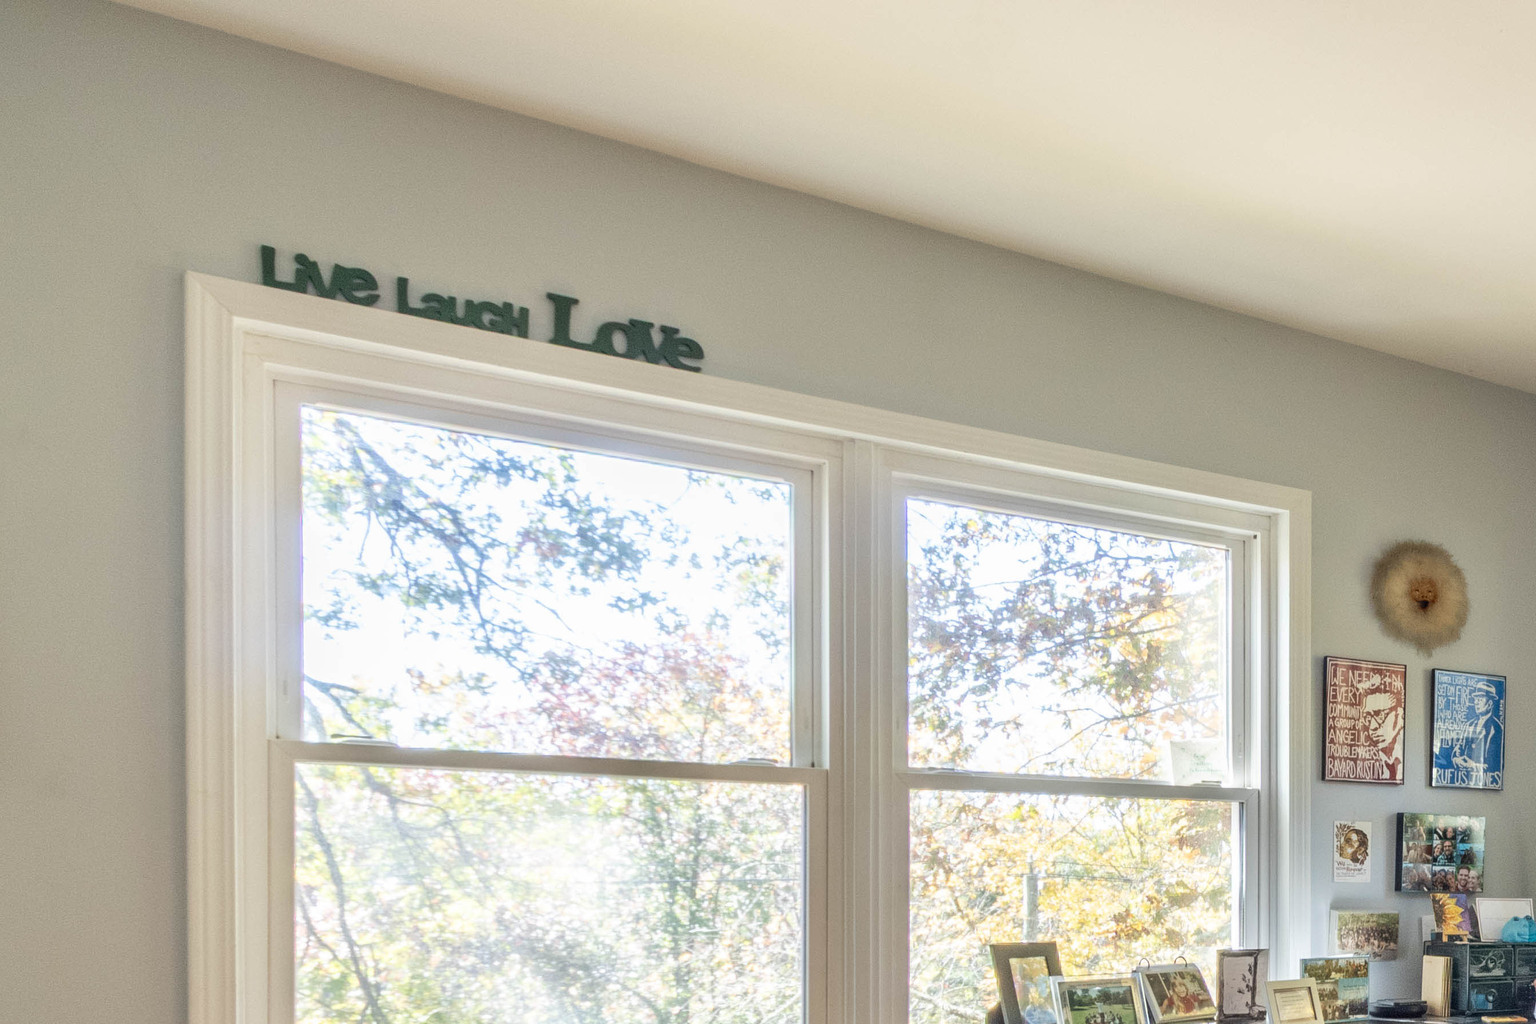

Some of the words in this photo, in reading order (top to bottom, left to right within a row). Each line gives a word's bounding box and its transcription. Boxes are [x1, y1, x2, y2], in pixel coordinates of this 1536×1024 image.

[1331, 666, 1346, 686] WE
[1329, 686, 1361, 703] EVERY
[1328, 729, 1370, 745] ANGELIC
[1328, 758, 1356, 778] BAYARD
[1434, 767, 1468, 786] RUFUS
